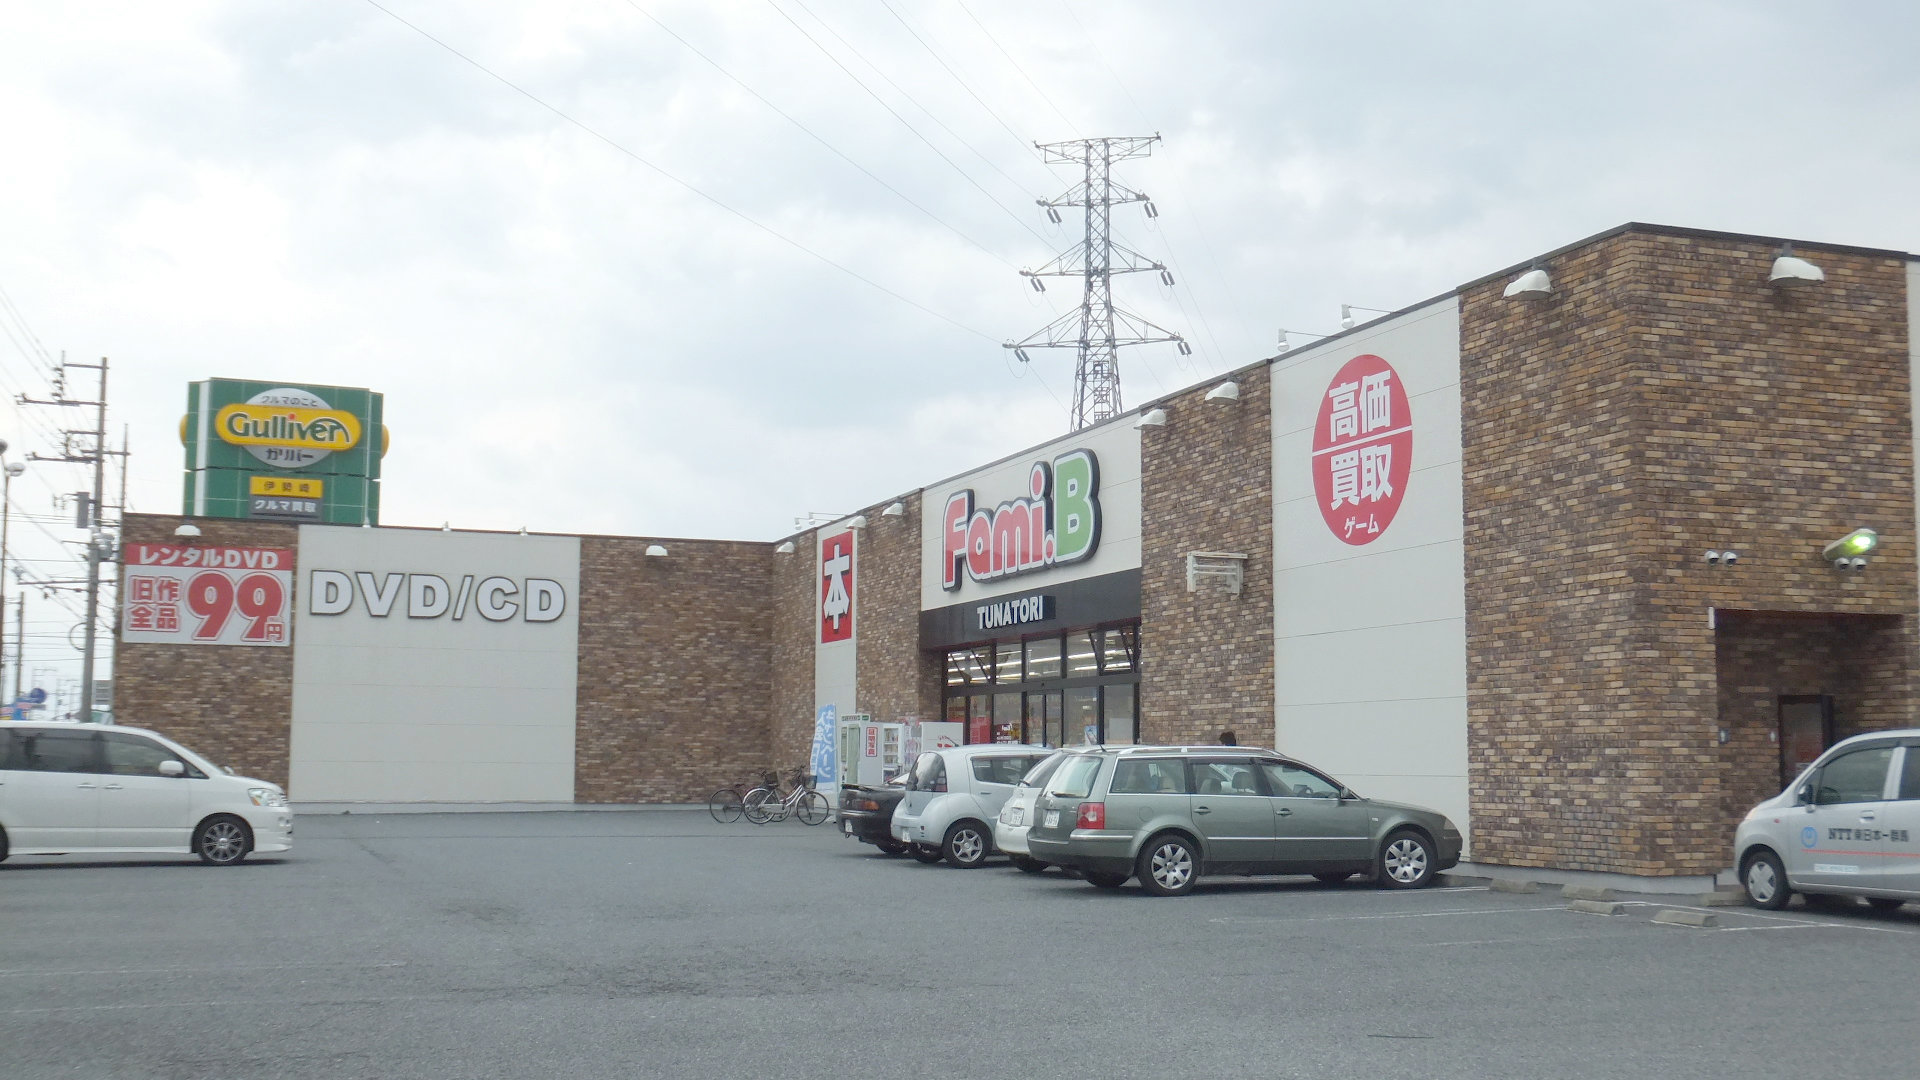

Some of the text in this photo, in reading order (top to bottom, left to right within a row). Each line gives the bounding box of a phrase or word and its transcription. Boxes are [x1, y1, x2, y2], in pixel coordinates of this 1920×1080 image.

[261, 395, 318, 408] クルマのこと
[1328, 370, 1391, 442] 高価
[226, 411, 351, 444] Gulliver
[266, 447, 314, 462] ガリバー
[1331, 444, 1393, 511] 買取
[255, 500, 316, 512] クルマ買取
[942, 449, 1102, 592] Fami.B
[1344, 513, 1379, 539] ゲーム
[139, 546, 279, 569] レンタルDVD
[129, 575, 183, 604] 旧作
[309, 569, 566, 622] DVD/CD
[823, 544, 850, 630] 本
[127, 604, 180, 632] 全品
[976, 595, 1044, 629] TUNATORI
